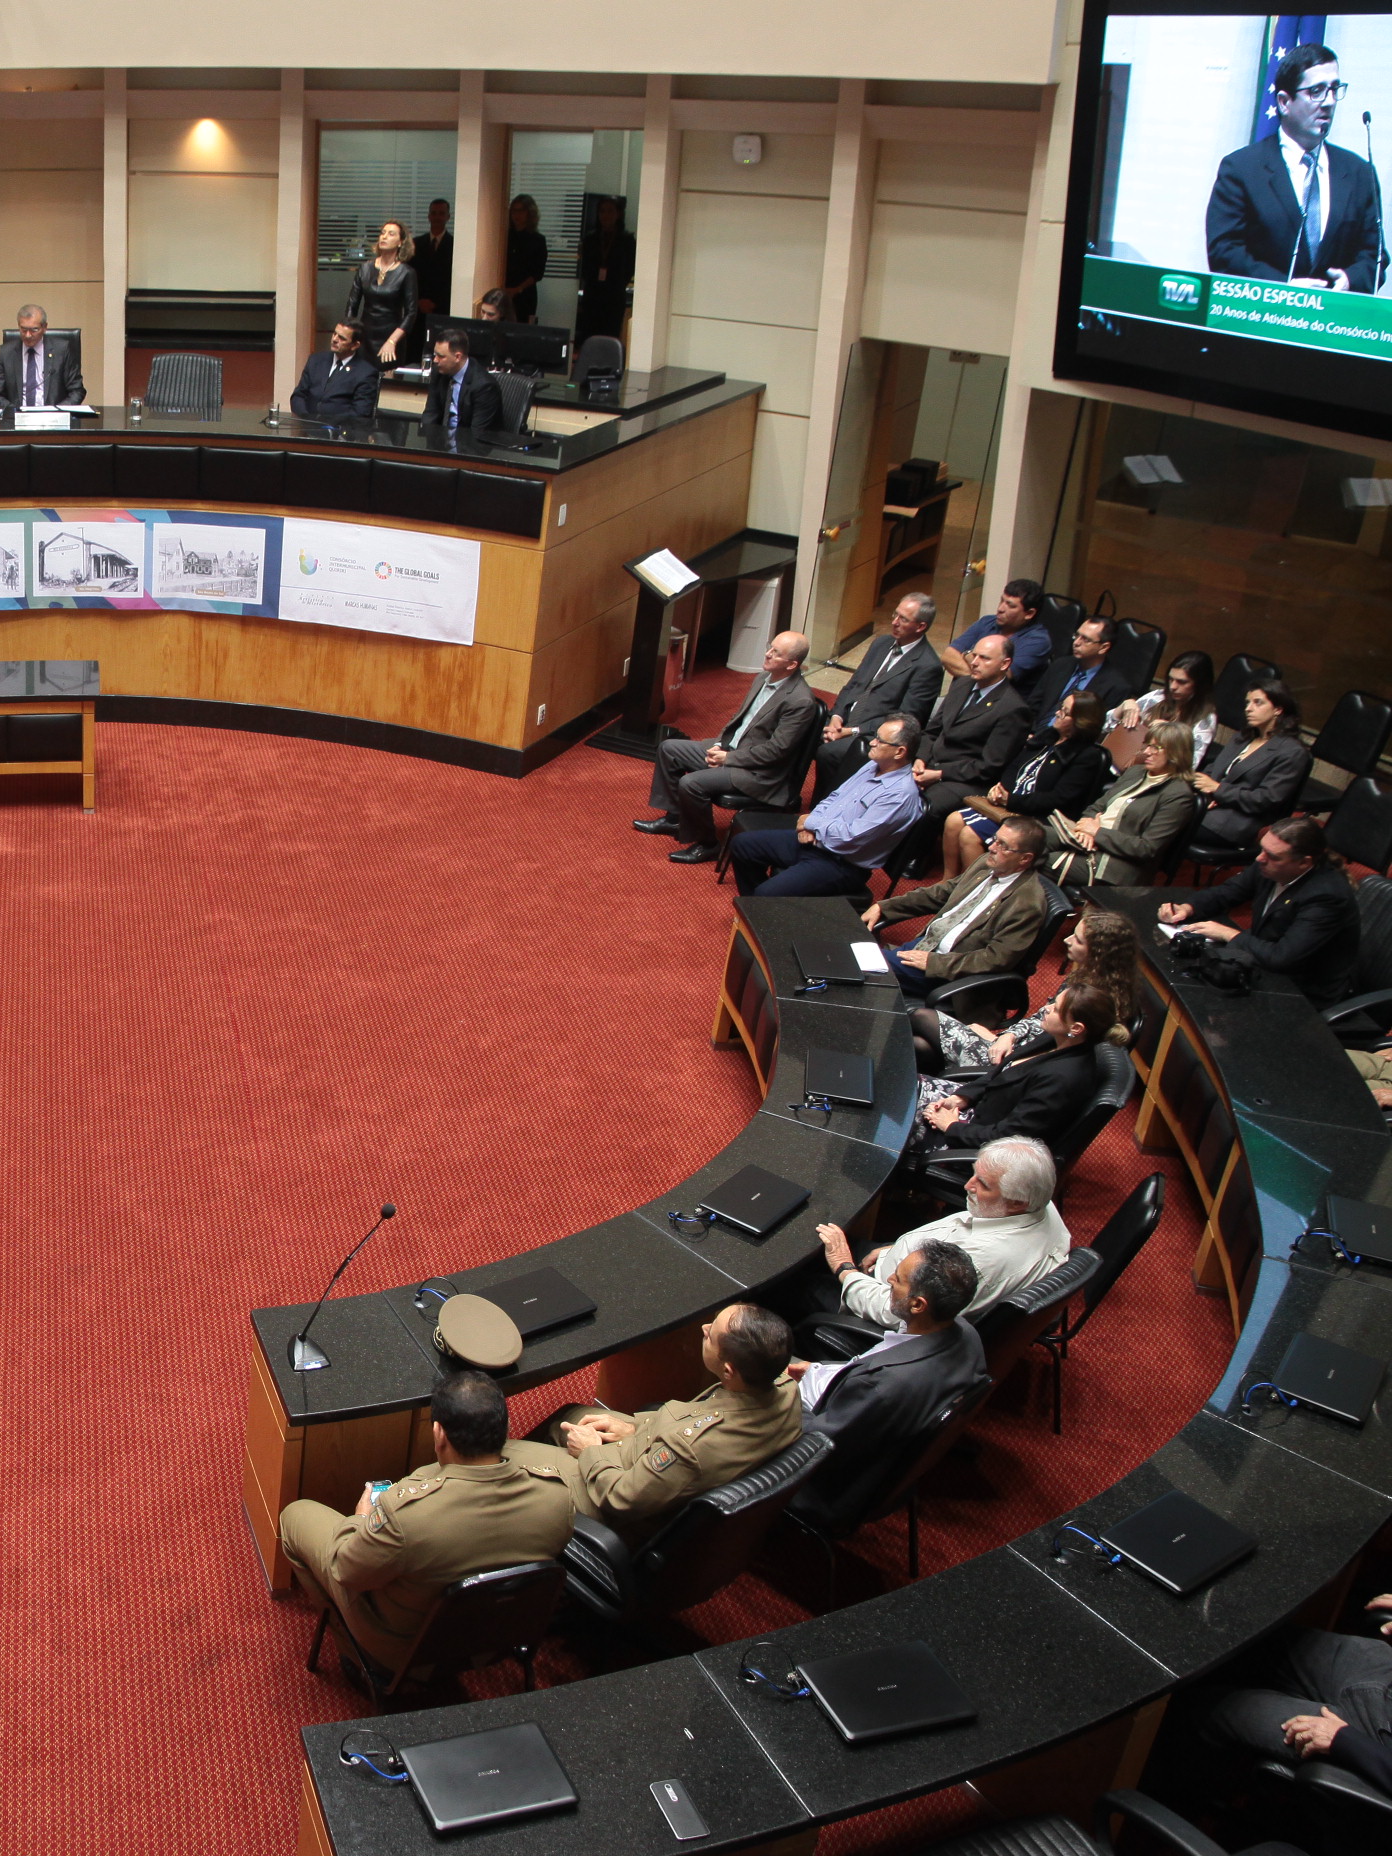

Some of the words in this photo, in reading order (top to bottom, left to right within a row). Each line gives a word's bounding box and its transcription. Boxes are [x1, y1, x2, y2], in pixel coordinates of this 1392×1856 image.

[1211, 281, 1261, 300] SESSÃO
[1263, 288, 1325, 310] ESPECIAL
[1210, 304, 1222, 315] 20
[1223, 306, 1247, 319] Anos
[1248, 310, 1261, 322] de
[1262, 312, 1309, 330] Atividade
[1310, 320, 1325, 332] do
[1326, 322, 1378, 340] Consórcio
[394, 566, 404, 574] THE
[404, 568, 422, 578] GLOBAL
[424, 571, 440, 580] GOALS
